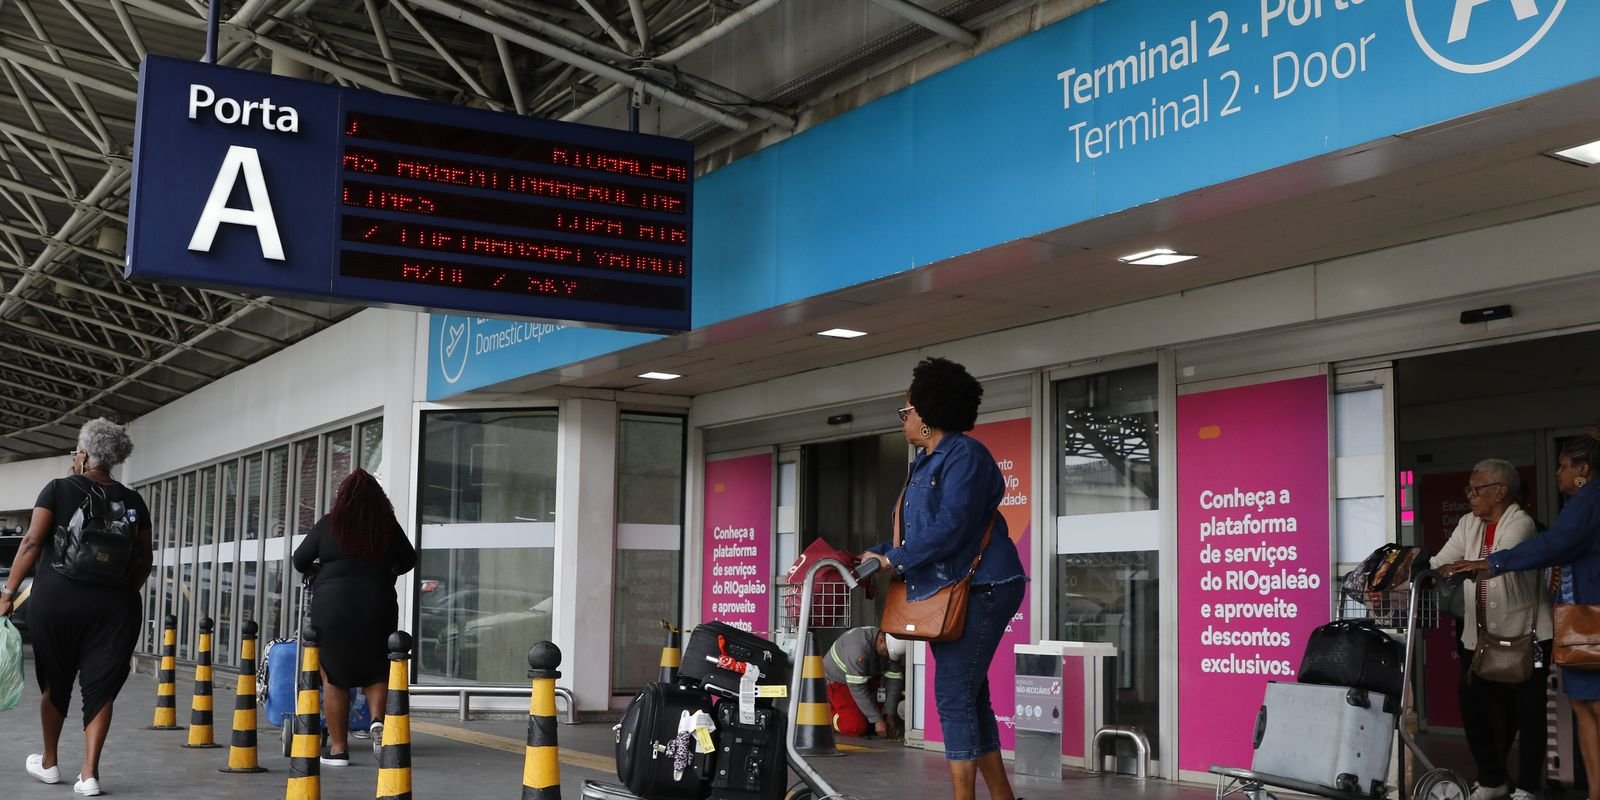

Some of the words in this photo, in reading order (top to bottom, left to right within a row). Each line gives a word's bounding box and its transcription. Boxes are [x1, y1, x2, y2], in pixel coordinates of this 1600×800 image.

[1057, 19, 1198, 109] Terminal
[1207, 10, 1230, 57] 2
[188, 83, 299, 133] Porta
[1068, 78, 1209, 163] Terminal
[1219, 70, 1241, 117] 2
[1273, 32, 1377, 100] Door
[187, 145, 286, 261] A
[475, 322, 523, 356] Domestic
[1004, 475, 1020, 490] Vip
[1200, 487, 1276, 512] Conheça
[1279, 488, 1290, 505] a
[713, 525, 748, 542] Conheça
[749, 527, 755, 541] a
[1200, 513, 1298, 542] plataforma
[713, 544, 758, 562] plataforma
[1200, 543, 1221, 564] de
[1224, 540, 1298, 568] serviços
[712, 563, 724, 577] de
[724, 561, 757, 580] serviços
[1200, 571, 1223, 591] do
[1226, 567, 1321, 596] RIOgaleão
[712, 581, 724, 595] do
[724, 579, 767, 598] RIOgaleão
[712, 602, 718, 613] e
[718, 599, 756, 618] aproveite
[1200, 602, 1212, 618] e
[1214, 596, 1298, 624] aproveite
[1200, 625, 1291, 647] descontos
[1200, 653, 1295, 676] exclusivos.
